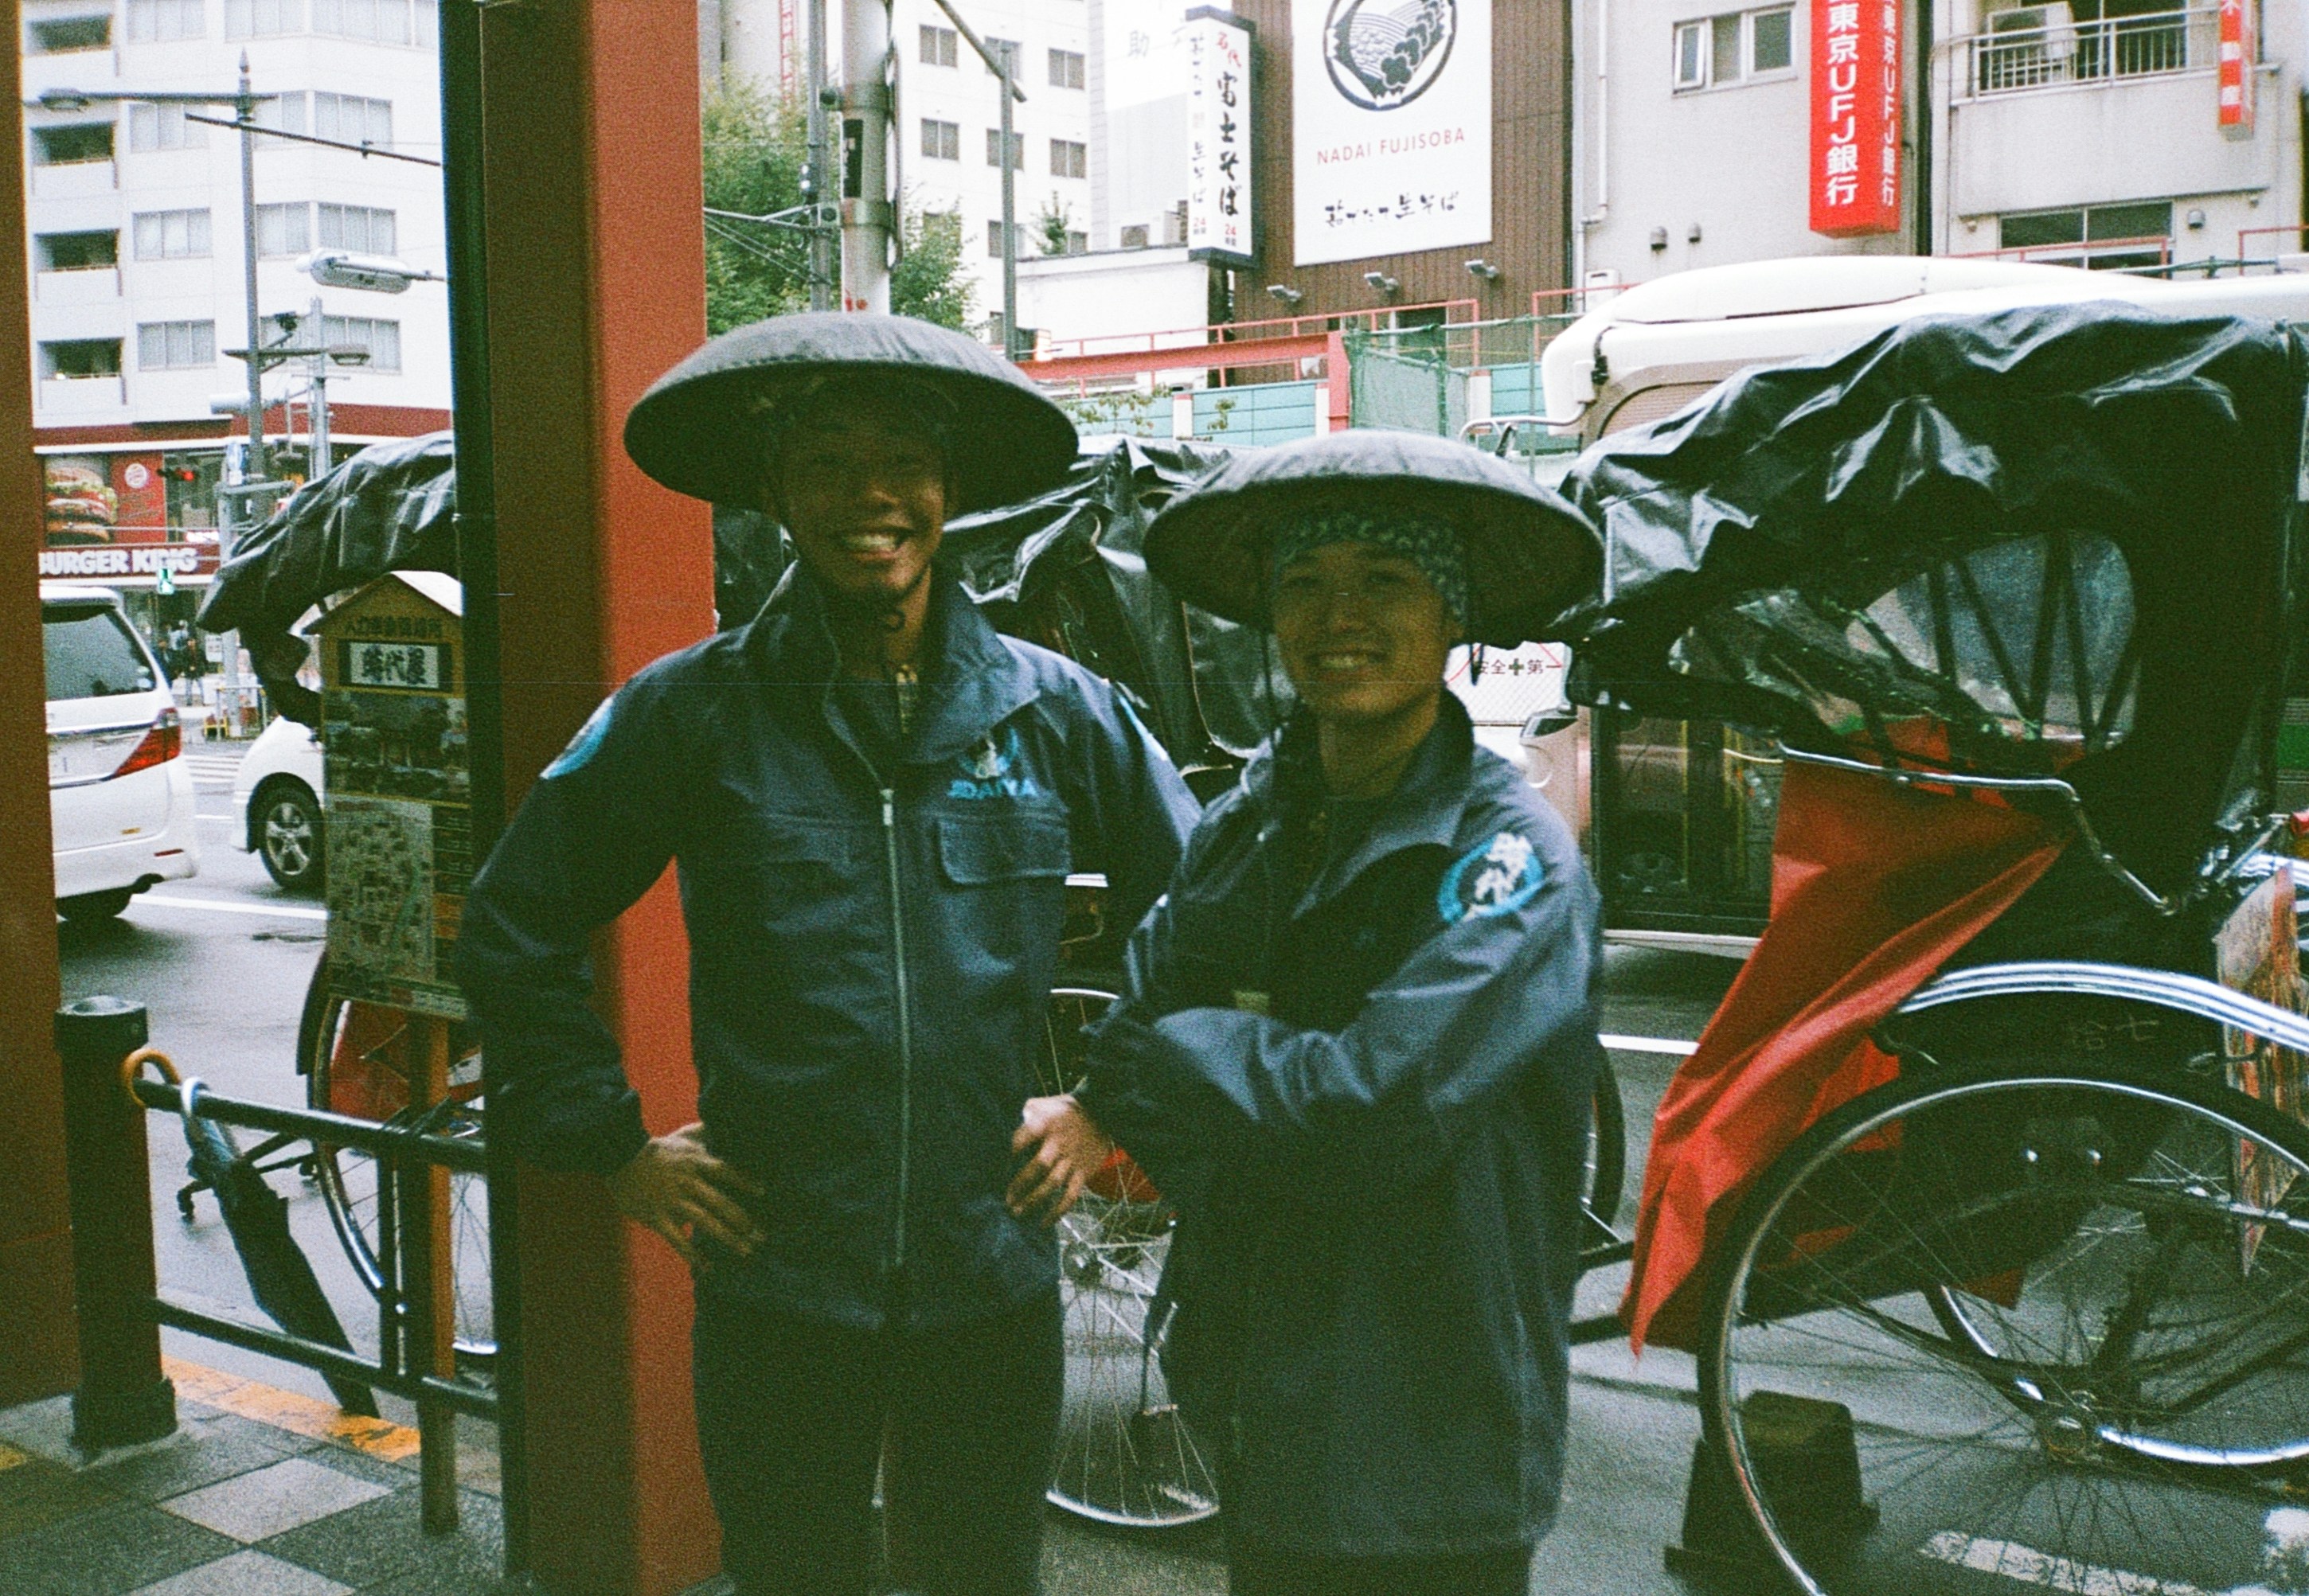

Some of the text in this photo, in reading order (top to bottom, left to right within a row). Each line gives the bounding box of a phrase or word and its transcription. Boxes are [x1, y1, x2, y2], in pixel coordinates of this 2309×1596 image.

[1826, 0, 1860, 206] 東京UFJ銀行
[1881, 0, 1897, 207] 東京UFJ銀行
[1317, 127, 1464, 164] NADAI FUJISOBA
[1225, 224, 1237, 236] 24
[131, 548, 199, 572] KING
